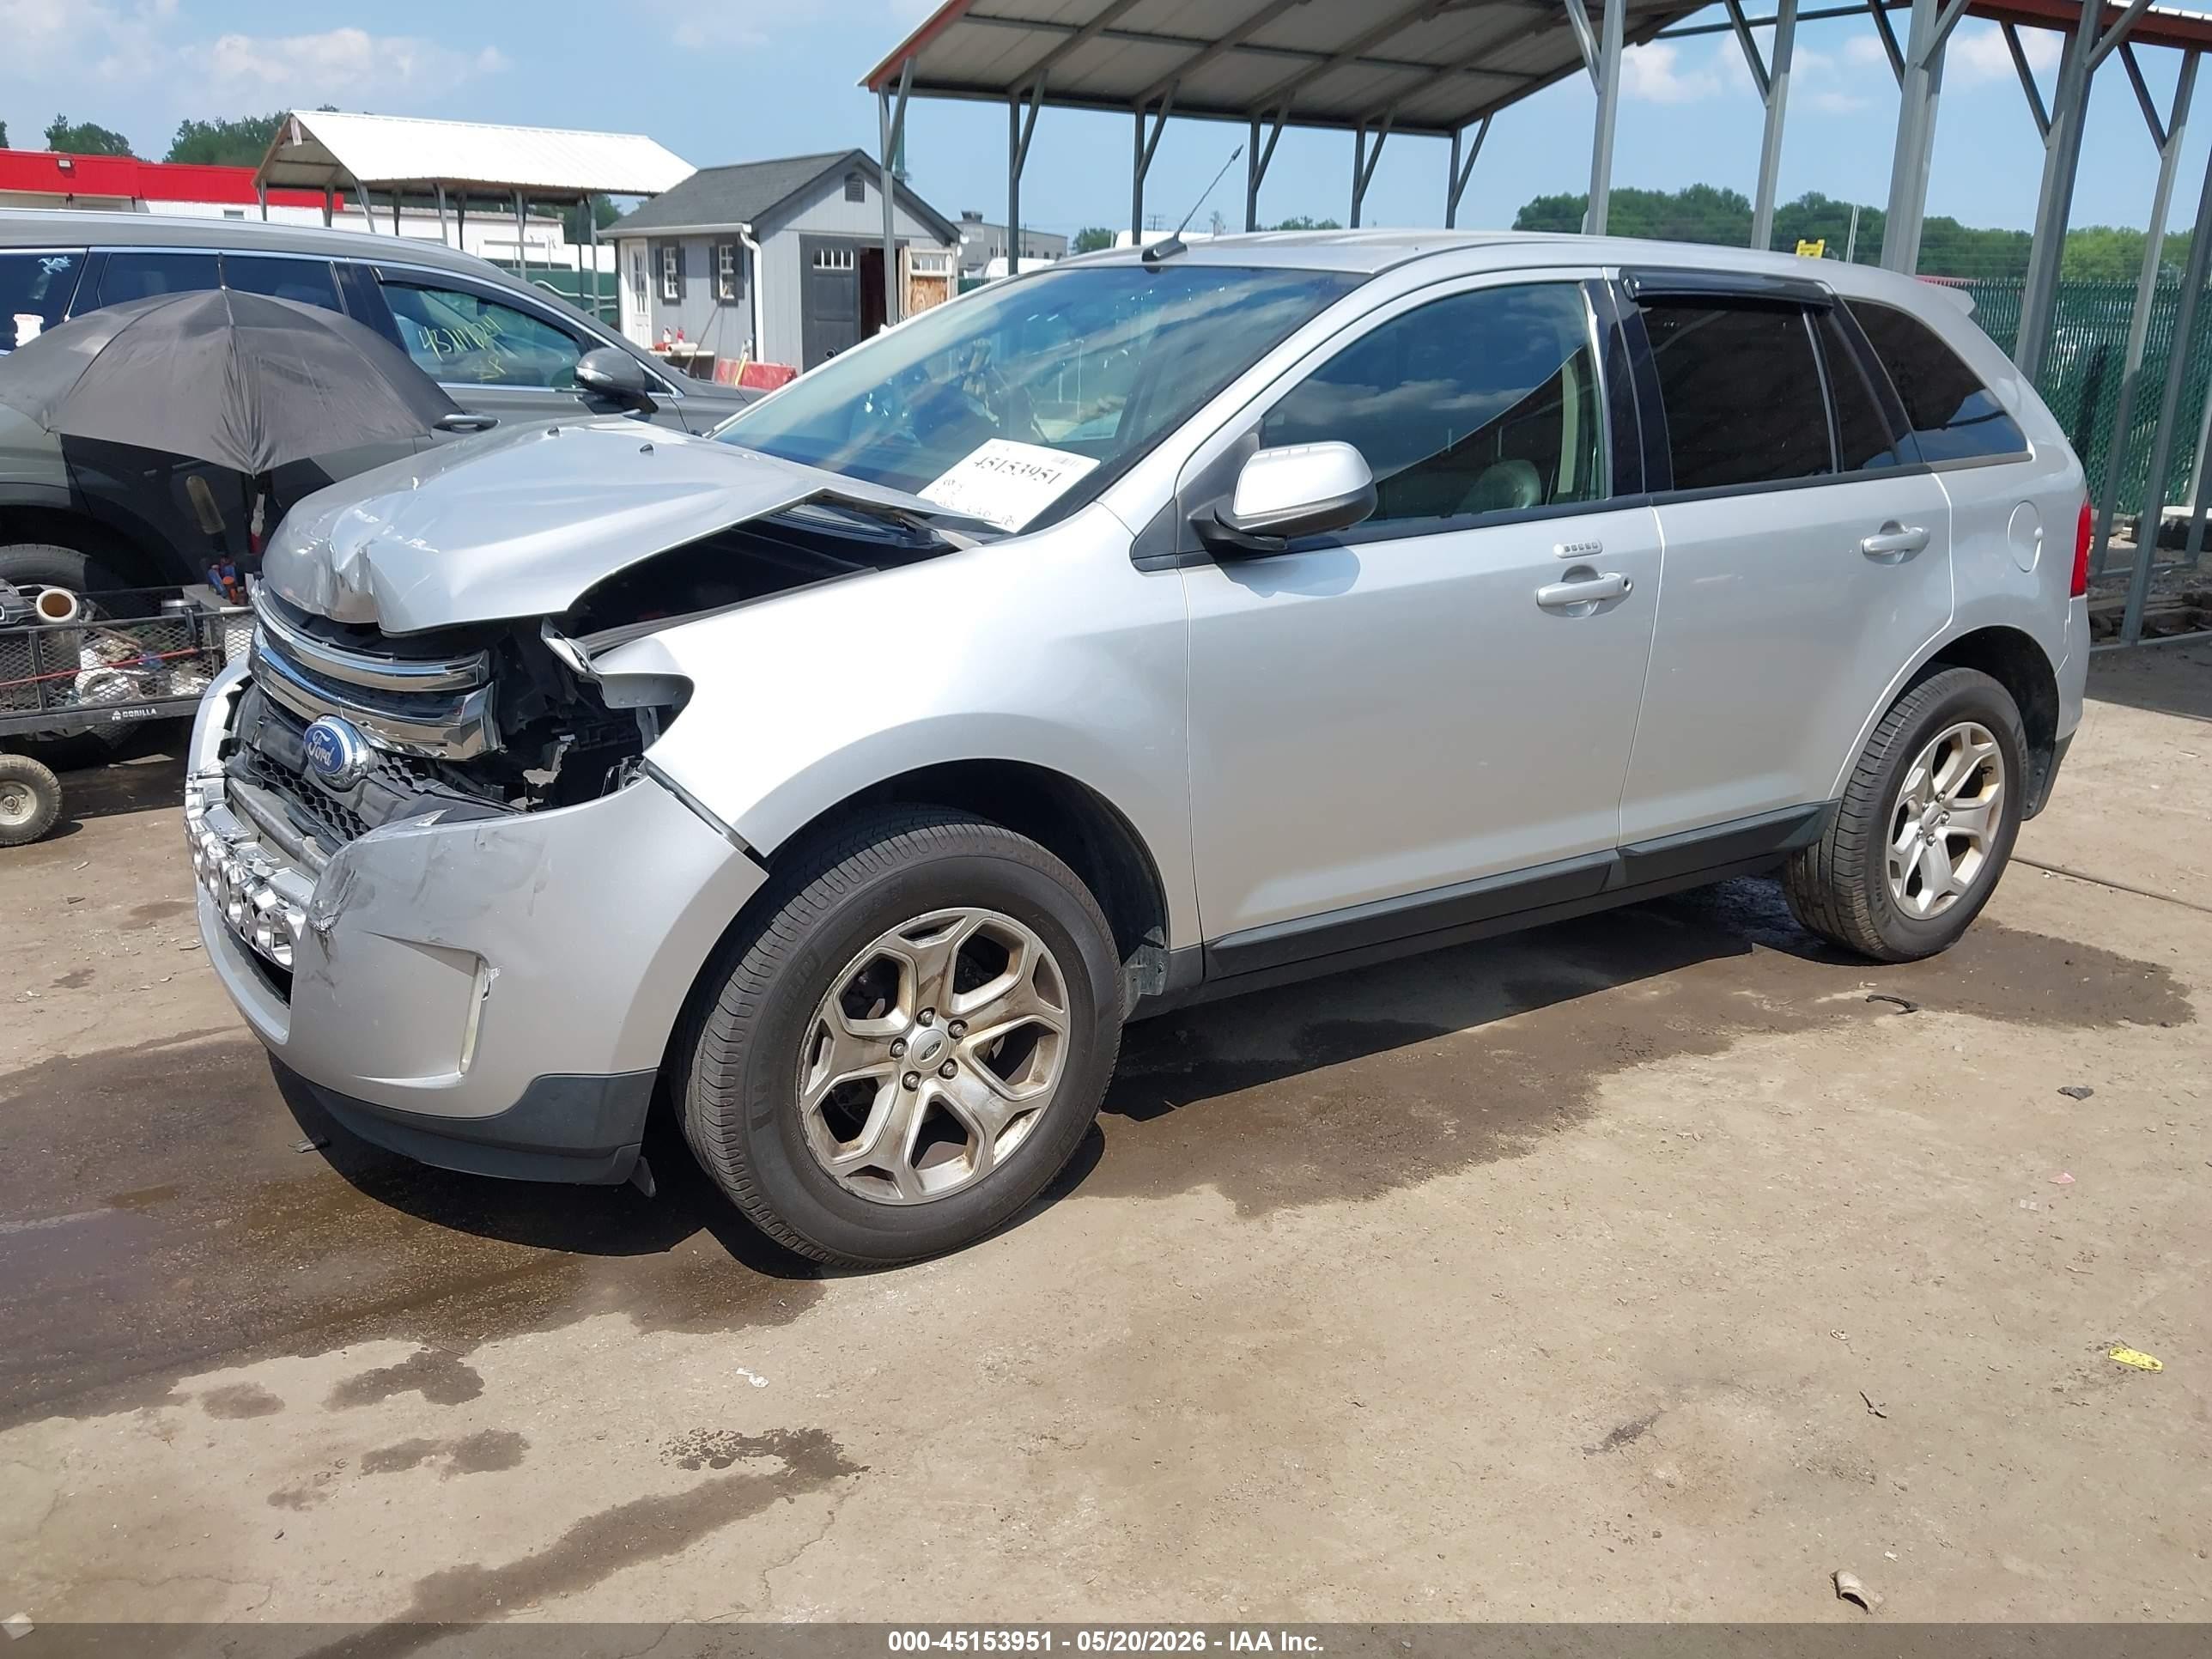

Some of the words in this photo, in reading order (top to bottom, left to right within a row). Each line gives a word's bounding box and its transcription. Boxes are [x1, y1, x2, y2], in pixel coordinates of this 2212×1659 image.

[974, 456, 1062, 484] 45153951
[122, 708, 157, 718] GORILLA
[307, 730, 336, 767] Ford
